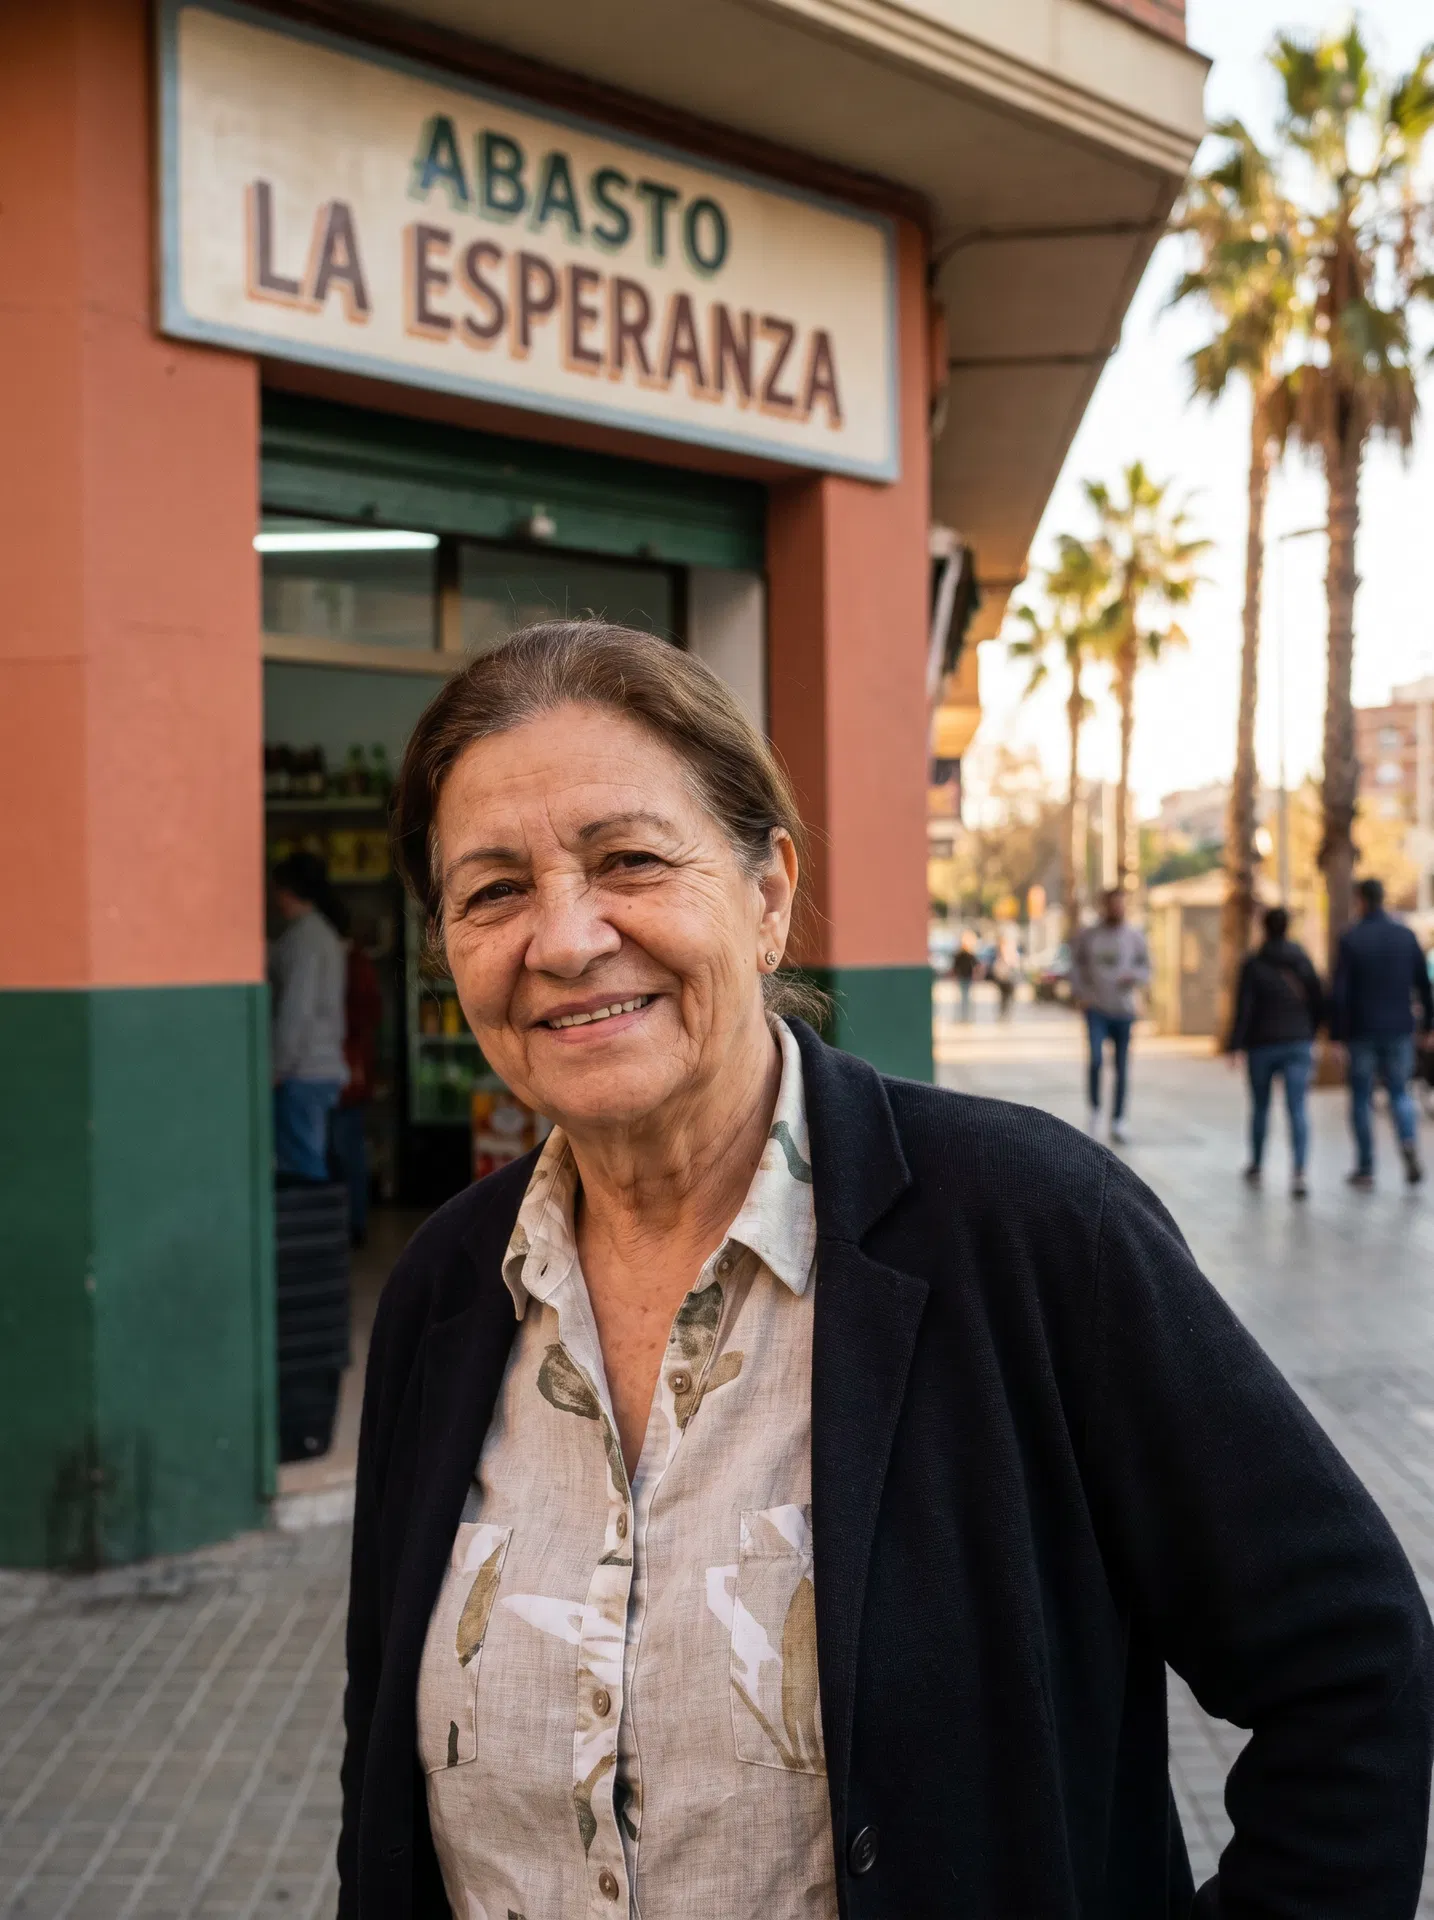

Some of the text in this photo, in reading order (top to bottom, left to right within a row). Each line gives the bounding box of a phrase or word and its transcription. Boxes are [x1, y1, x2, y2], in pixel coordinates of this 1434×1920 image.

[411, 113, 730, 279] ABASTO
[247, 180, 844, 430] LA ESPERANZA
